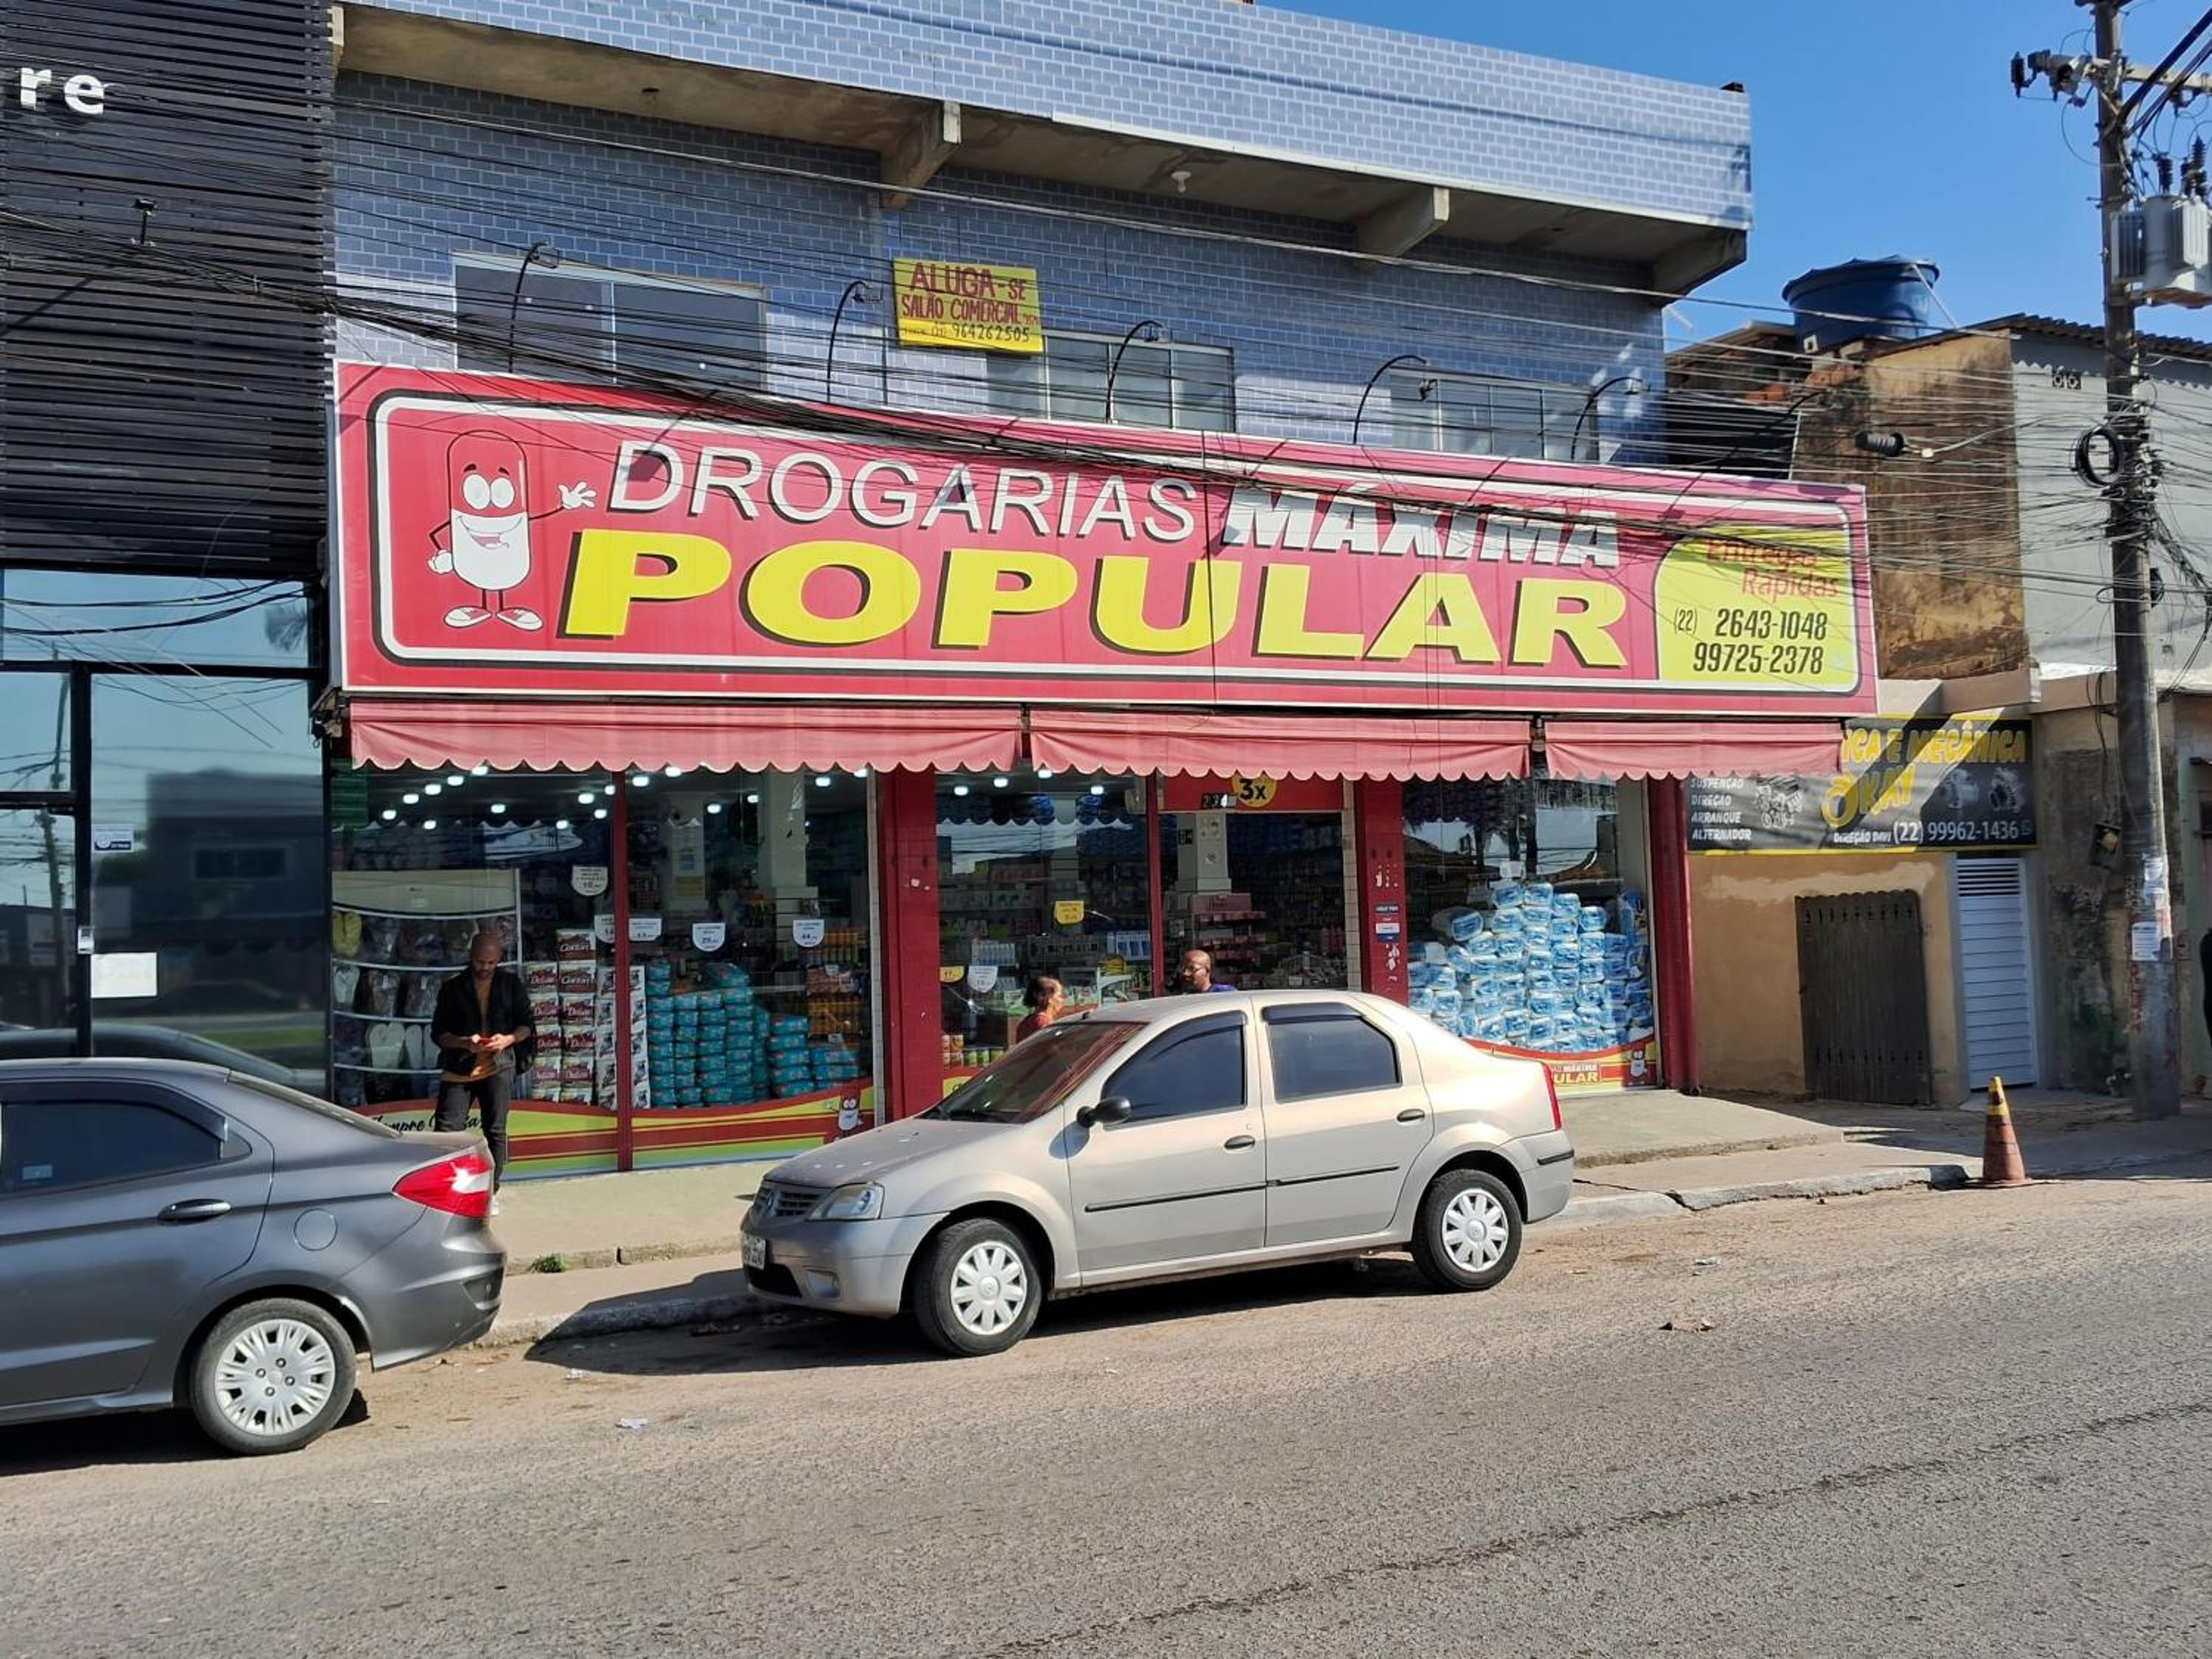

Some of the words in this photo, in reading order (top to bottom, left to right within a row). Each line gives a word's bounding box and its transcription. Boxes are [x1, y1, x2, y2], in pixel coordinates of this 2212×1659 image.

[901, 293, 945, 319] SALÃO
[950, 298, 1022, 324] COMERCIAL
[607, 439, 1197, 543] DROGARIAS
[1222, 483, 1621, 567] MÁXIMA
[556, 528, 1628, 669] POPULAR
[1674, 608, 1698, 635] (22)
[1715, 608, 1829, 641] 2643-1048
[1693, 643, 1824, 675] 99725-2378
[1886, 728, 1903, 763] E
[1906, 720, 2026, 763] MECÂNICA
[1691, 812, 1742, 824] ARRANQUE
[1893, 820, 1924, 845] (22)
[1928, 820, 2019, 843] 99962-1436
[1692, 828, 1753, 841] ALTERNADOR
